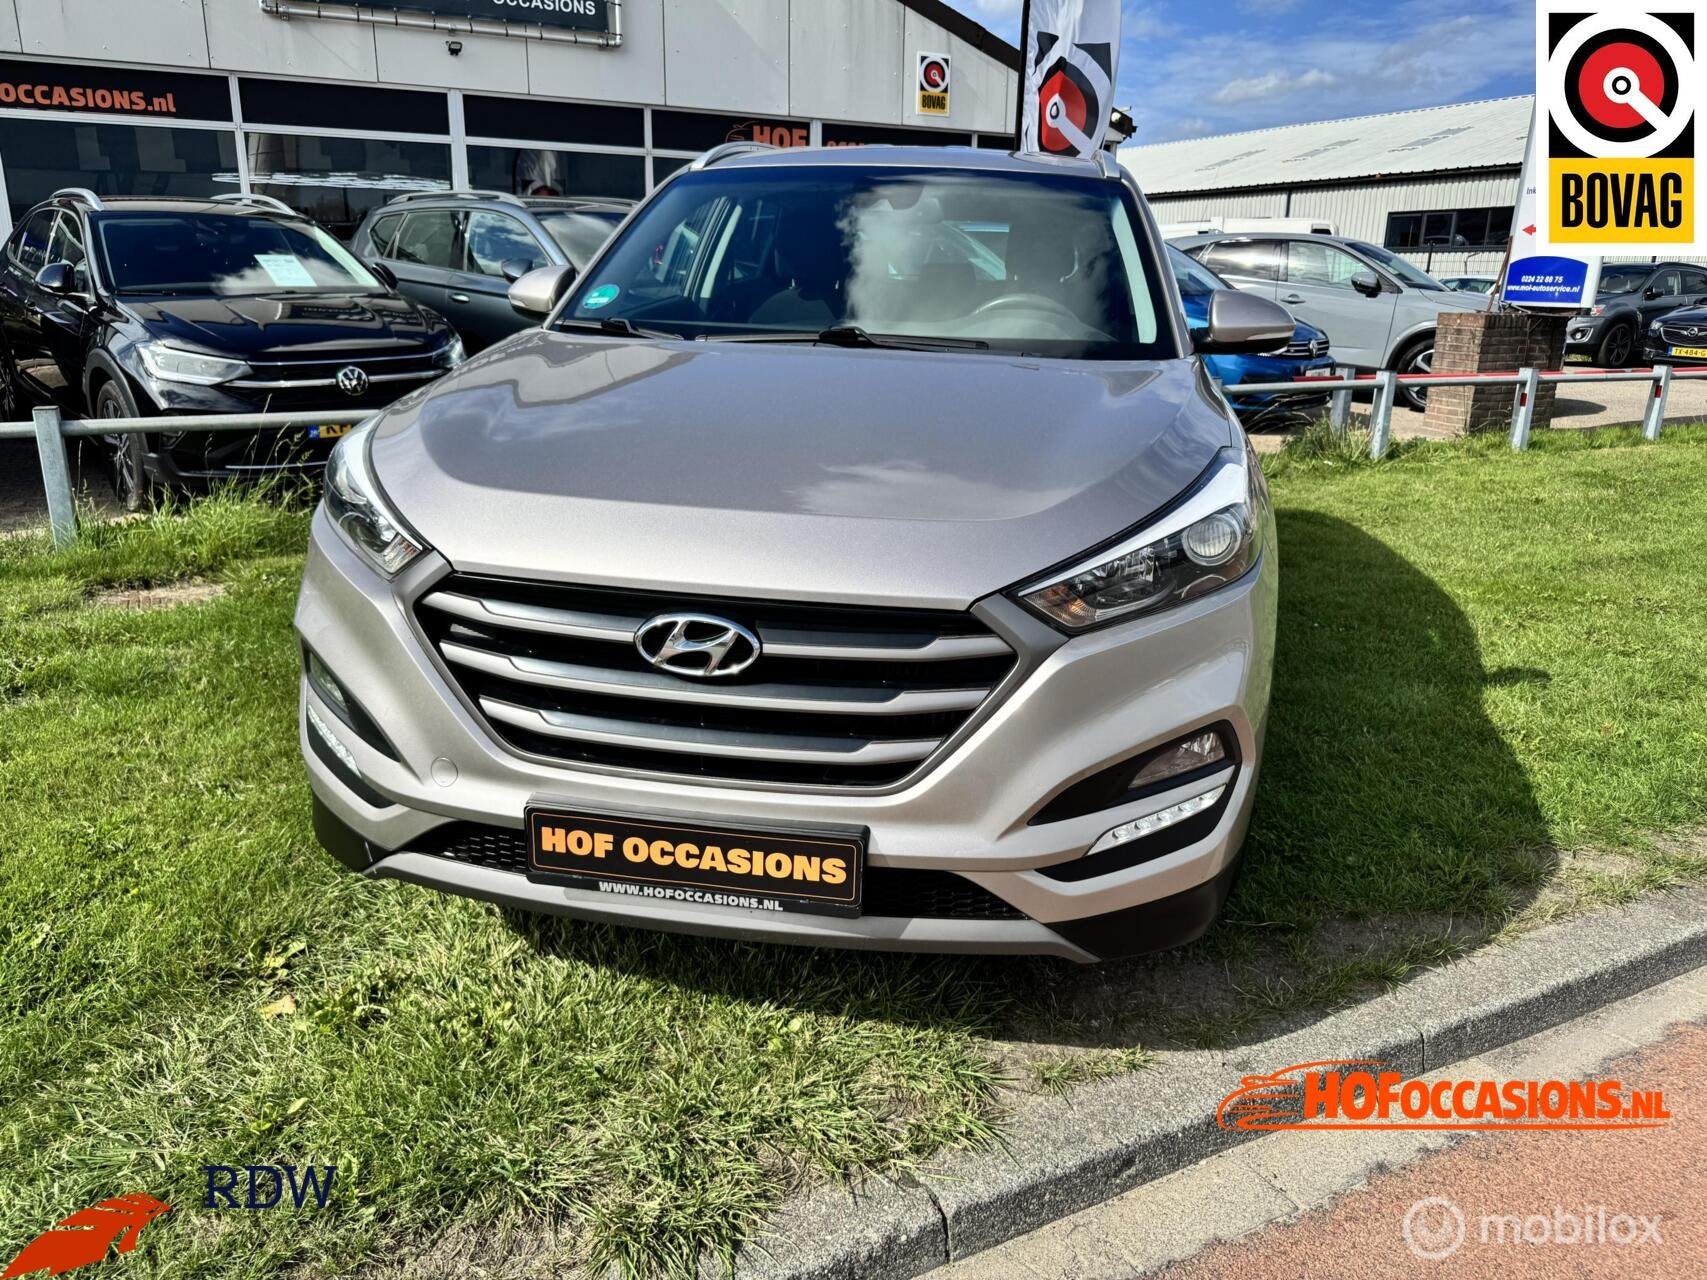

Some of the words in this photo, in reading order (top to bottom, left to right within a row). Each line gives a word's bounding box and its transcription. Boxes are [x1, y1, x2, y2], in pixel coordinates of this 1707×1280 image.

[0, 82, 176, 113] OCCASIONS.nl
[921, 94, 946, 110] BOVAG
[541, 826, 614, 859] HOF
[622, 837, 847, 884] OCCASIONS
[599, 881, 784, 911] WWW.HOFOCCASIONS.NL
